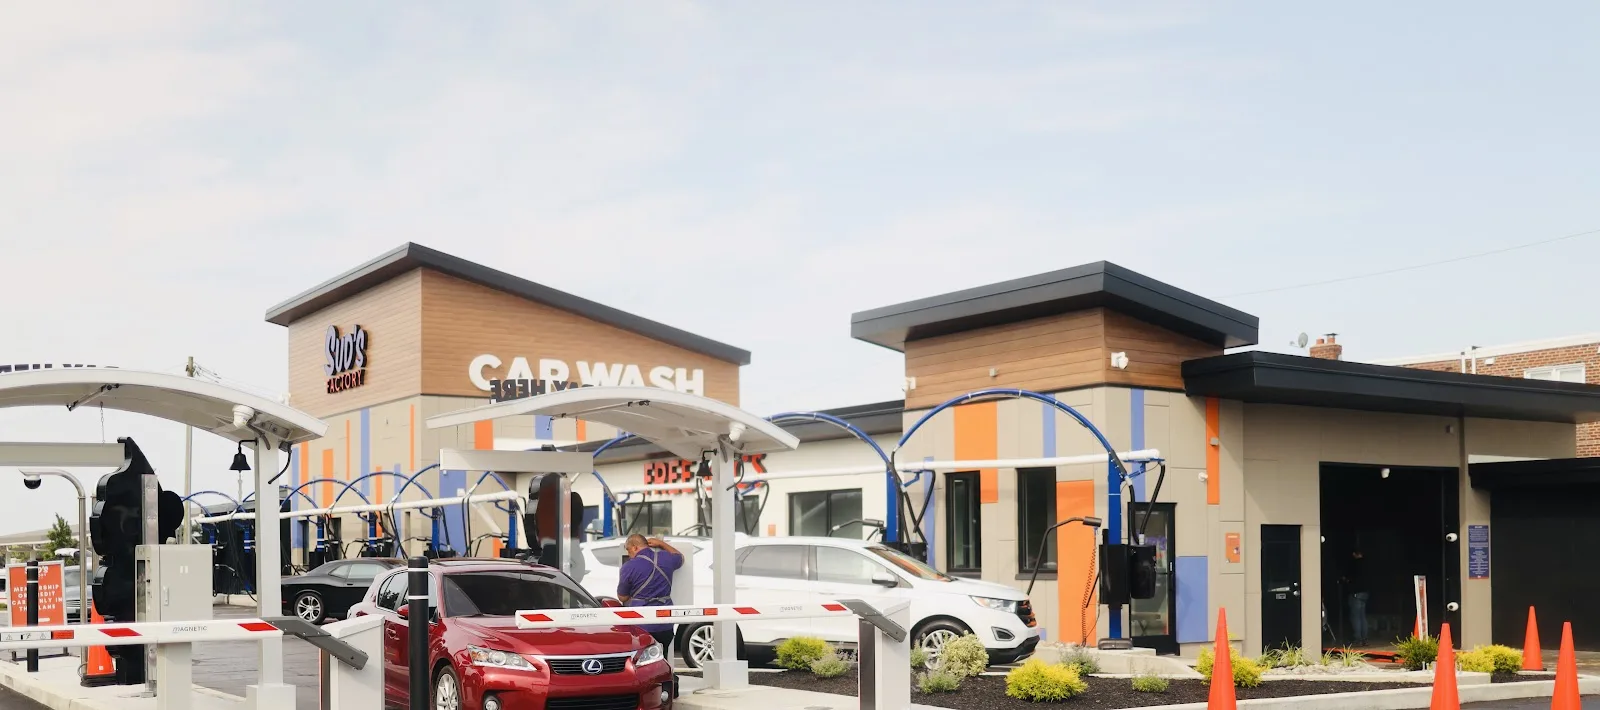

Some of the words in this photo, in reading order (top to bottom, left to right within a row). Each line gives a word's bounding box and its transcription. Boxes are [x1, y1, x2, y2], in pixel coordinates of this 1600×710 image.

[326, 369, 365, 394] FACTORY
[468, 353, 570, 393] CAR
[576, 360, 704, 397] WASH
